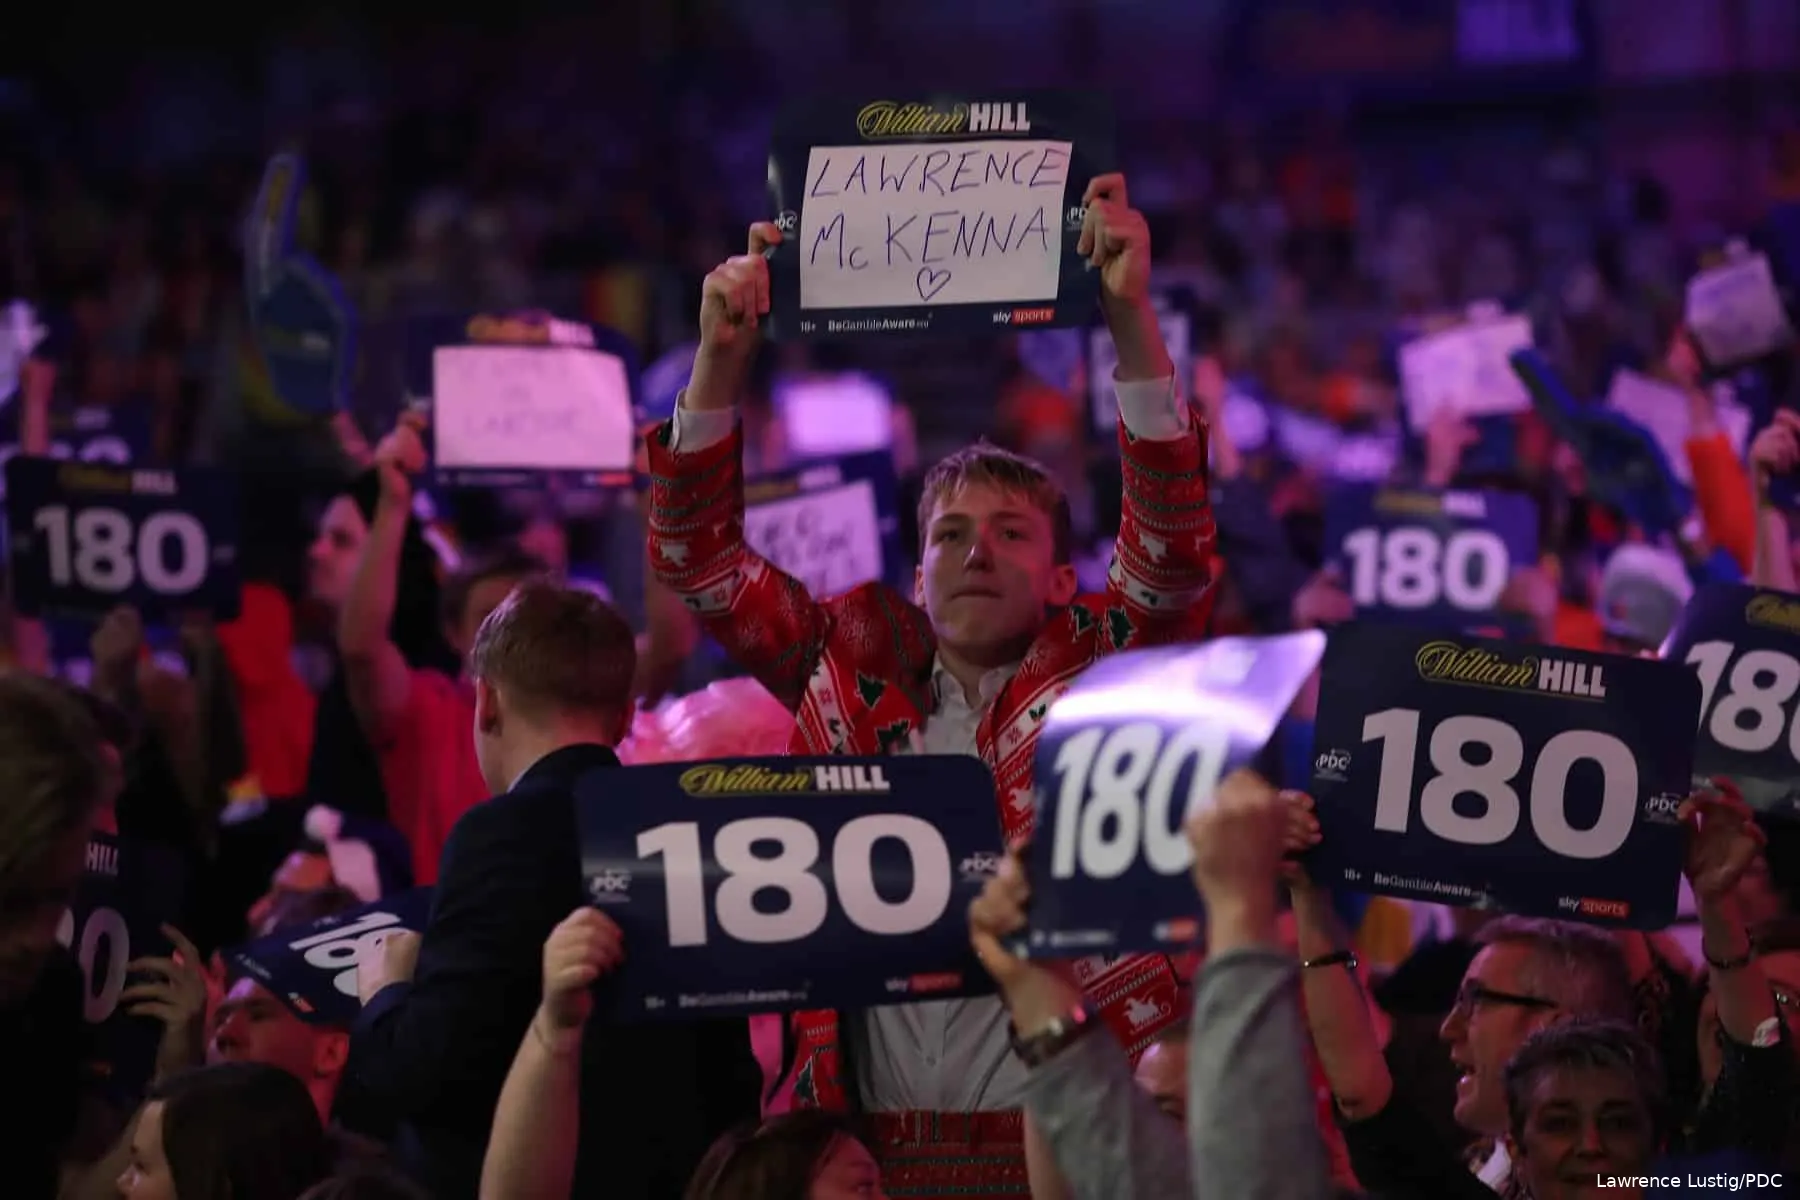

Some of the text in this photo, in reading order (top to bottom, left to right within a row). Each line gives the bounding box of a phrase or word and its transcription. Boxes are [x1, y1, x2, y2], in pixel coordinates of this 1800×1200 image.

[857, 101, 1031, 138] William HILL
[811, 148, 1068, 198] LAWRENCE
[993, 311, 1012, 325] sky
[34, 505, 208, 593] 180
[1342, 527, 1509, 611] 180
[1415, 641, 1606, 697] William HILL
[1685, 640, 1800, 764] 18
[680, 764, 890, 797] William HILL
[1316, 752, 1348, 770] PDC
[1361, 707, 1639, 859] 180
[1051, 720, 1230, 879] 180
[85, 842, 119, 876] HILL
[636, 813, 952, 947] 180
[1558, 895, 1627, 918] sky sports
